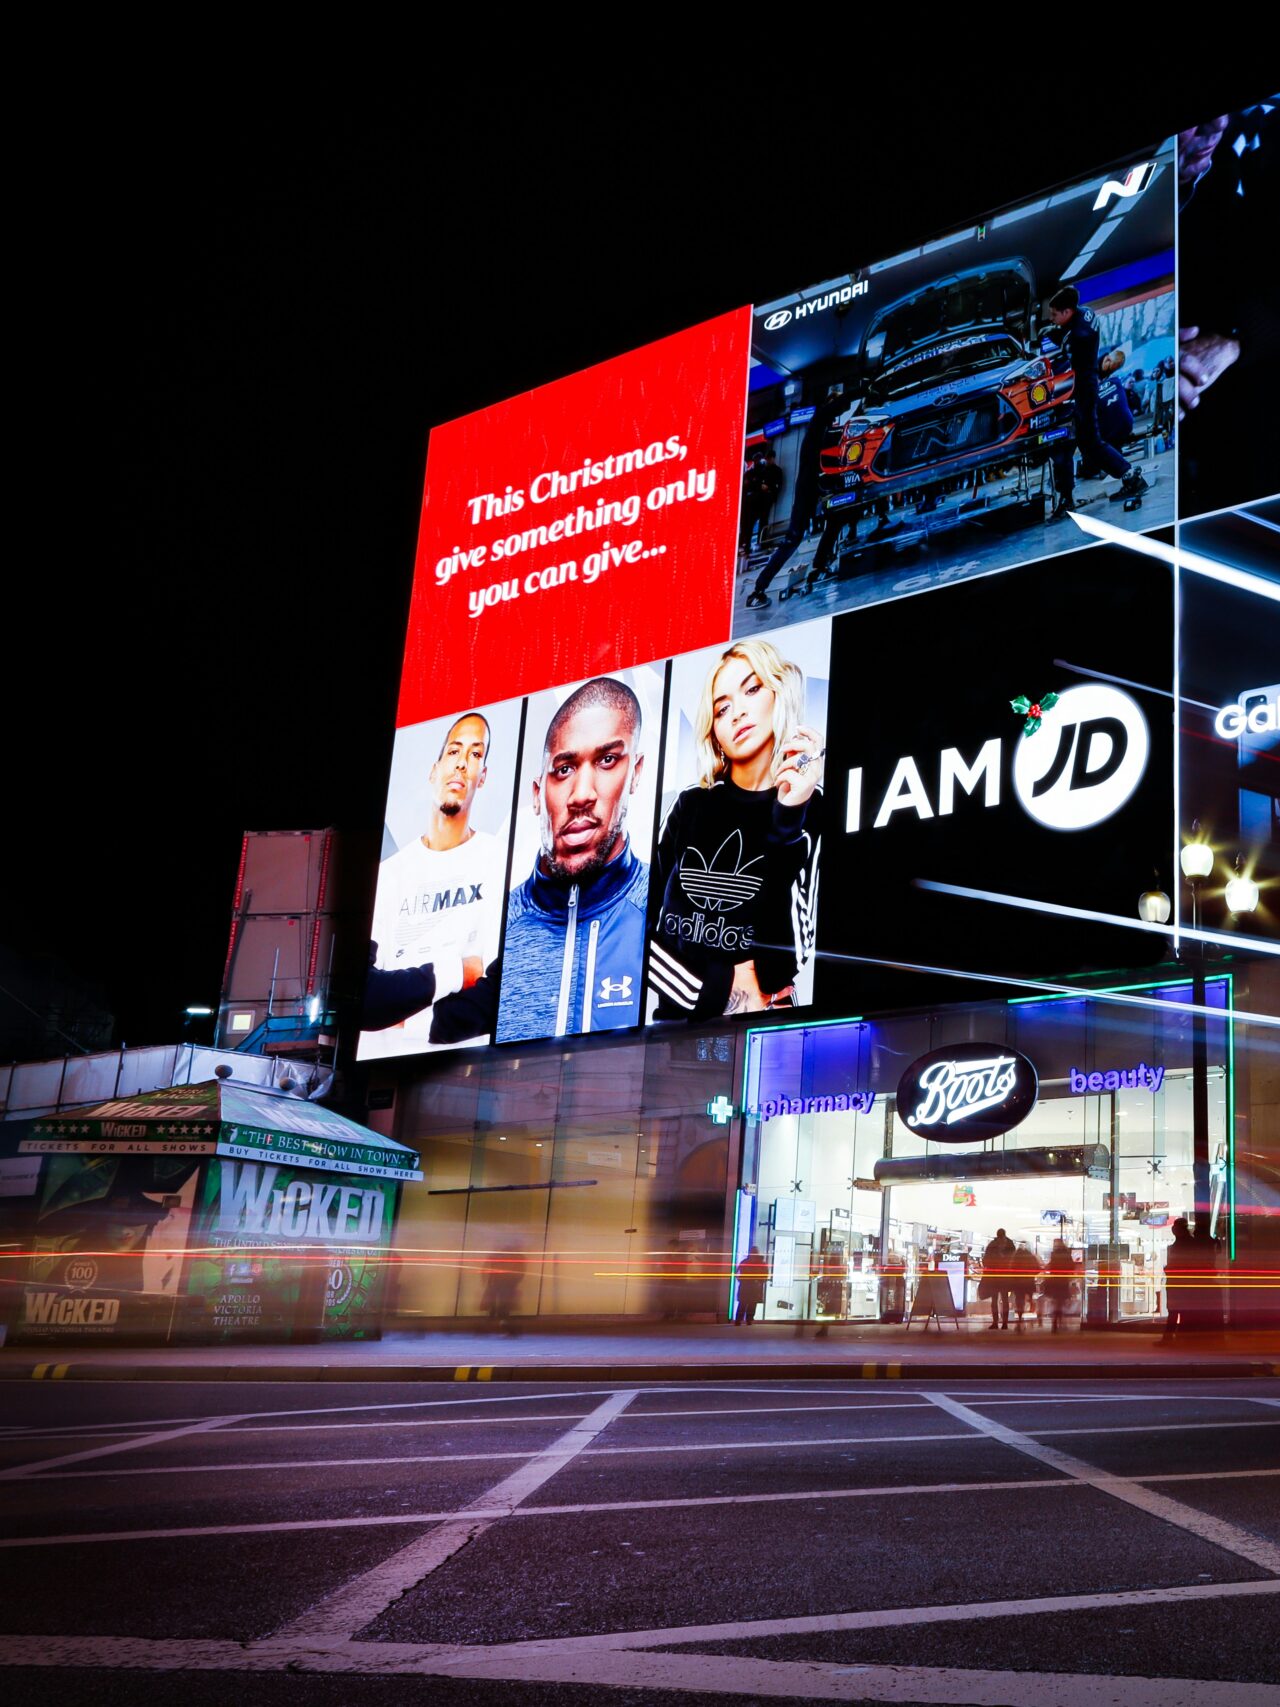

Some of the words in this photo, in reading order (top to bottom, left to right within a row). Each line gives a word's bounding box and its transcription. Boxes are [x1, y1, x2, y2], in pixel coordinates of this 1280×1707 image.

[795, 280, 869, 320] HYUNDAI
[467, 485, 525, 525] This
[530, 435, 689, 504] Christmas,
[435, 546, 487, 586] give
[490, 497, 640, 562] something
[646, 468, 717, 511] only
[468, 579, 520, 618] you
[524, 562, 578, 593] can
[581, 540, 667, 583] give...
[846, 767, 863, 834] I
[873, 738, 1002, 828] AM
[1031, 716, 1129, 798] JD
[399, 893, 431, 916] AIR
[432, 883, 483, 913] MAX
[665, 912, 754, 950] adidas
[907, 1055, 1016, 1127] Boots
[1070, 1062, 1164, 1093] beauty
[761, 1091, 876, 1122] pharmacy
[26, 1142, 80, 1151] TICKETS
[91, 1143, 115, 1151] FOR
[127, 1143, 150, 1151] ALL
[162, 1143, 207, 1152] SHOWS
[229, 1147, 249, 1156] BUY
[259, 1151, 300, 1164] TICKETS
[308, 1158, 326, 1168] FOR
[334, 1162, 351, 1171] ALL
[358, 1166, 388, 1175] SHOWS
[394, 1170, 414, 1179] HERE
[277, 1136, 310, 1152] BEST
[310, 1141, 348, 1158] SHOW
[350, 1147, 365, 1160] IN
[942, 1253, 961, 1262] Dior
[213, 1304, 263, 1315] VICTORIA
[219, 1294, 261, 1305] APOLLO
[213, 1316, 260, 1326] THEATRE
